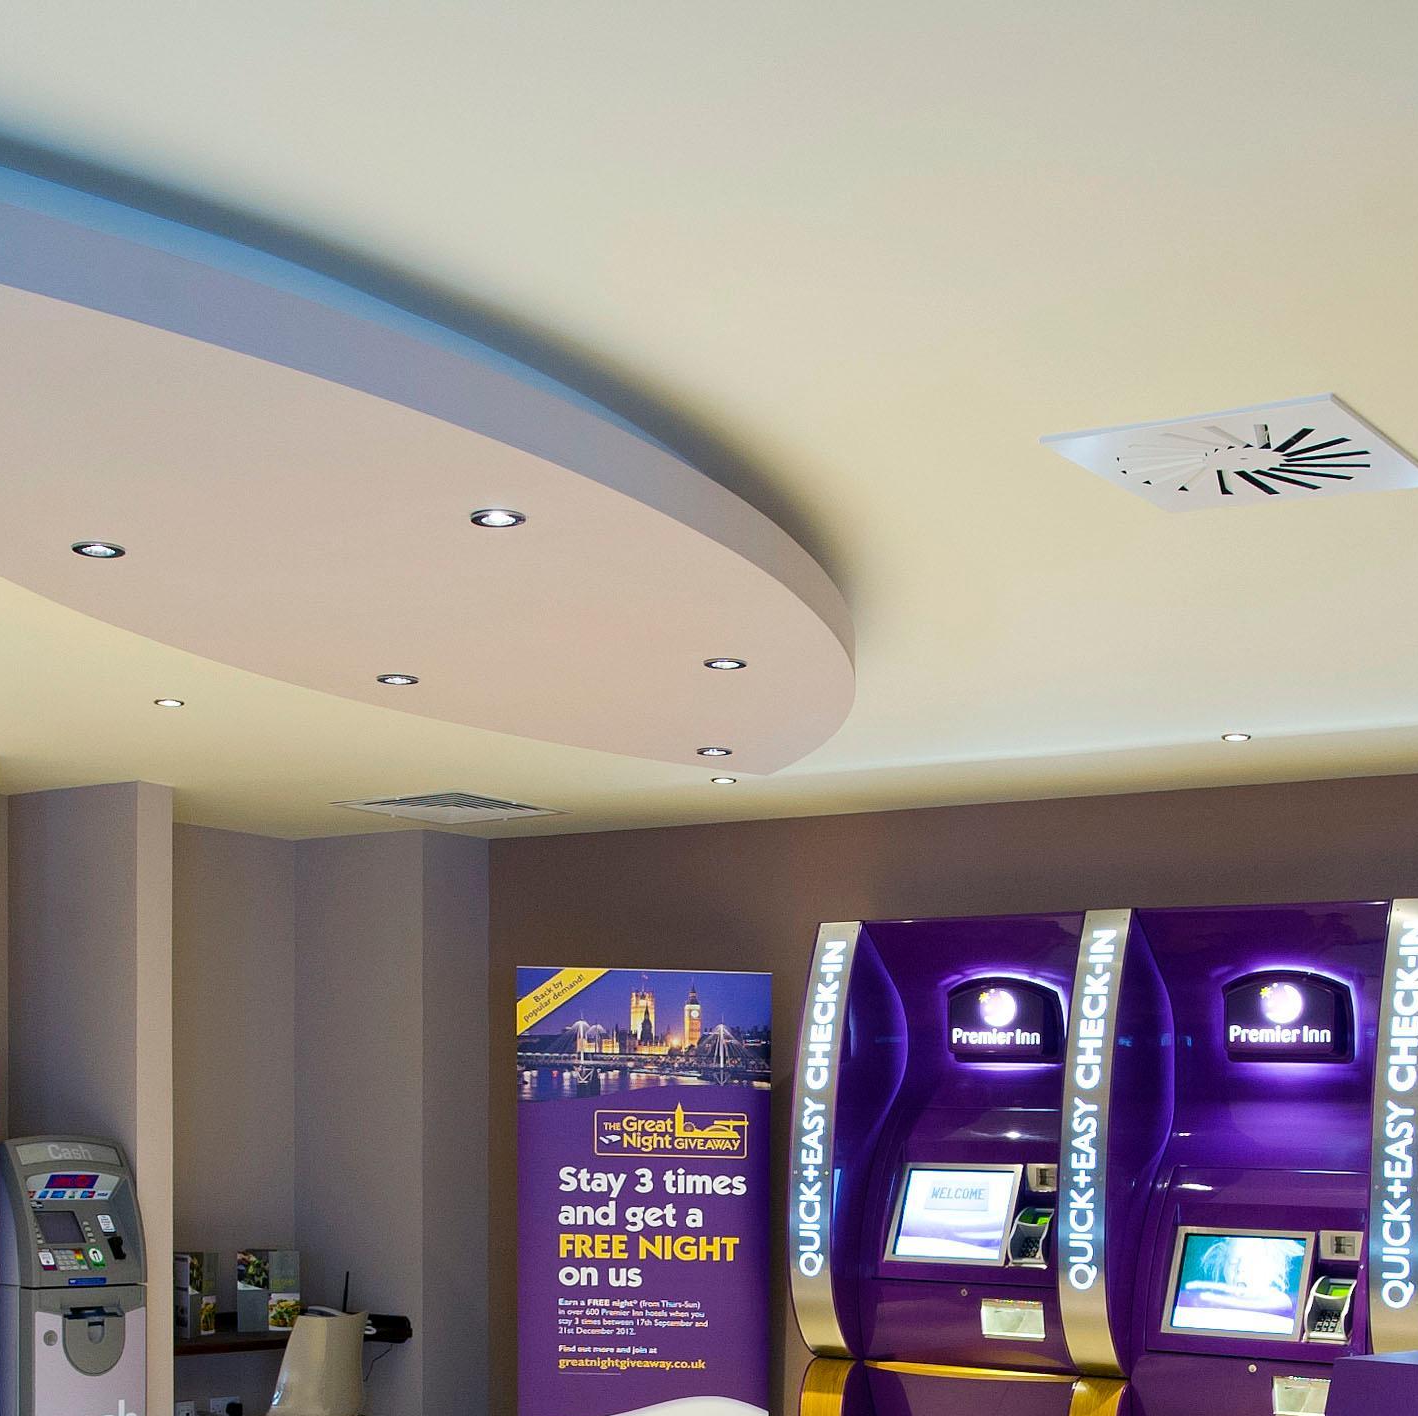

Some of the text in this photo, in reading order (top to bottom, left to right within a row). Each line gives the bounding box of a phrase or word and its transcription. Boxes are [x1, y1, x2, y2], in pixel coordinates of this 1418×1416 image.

[533, 980, 563, 1003] Back by
[523, 998, 551, 1022] popular
[951, 1026, 1042, 1046] Premier Inn
[1228, 1024, 1332, 1045] Premier Inn
[798, 940, 848, 1278] QUICK+EASY CHECK-IN
[1068, 928, 1118, 1292] QUICK+EASY CHECK-IN
[603, 1115, 674, 1133] THE Great
[47, 1144, 93, 1161] Cash
[622, 1133, 742, 1152] Night GIVEAWAY
[558, 1166, 748, 1198] Stay 3 times
[930, 1186, 985, 1201] WELCOME
[1381, 1098, 1417, 1309] QUICK+EASY
[558, 1200, 703, 1232] and get a
[558, 1233, 740, 1262] FREE NIGHT
[558, 1266, 643, 1287] on us
[558, 1298, 610, 1306] Earn FREE
[558, 1318, 573, 1326] stay
[654, 1319, 693, 1328] September
[601, 1308, 630, 1316] Premier
[645, 1309, 668, 1317] hotels
[669, 1310, 690, 1318] when
[576, 1326, 614, 1335] December
[558, 1345, 576, 1353] Find
[616, 1346, 631, 1354] and
[632, 1346, 648, 1355] join
[558, 1356, 706, 1371] greatnightgiveaway.co.uk
